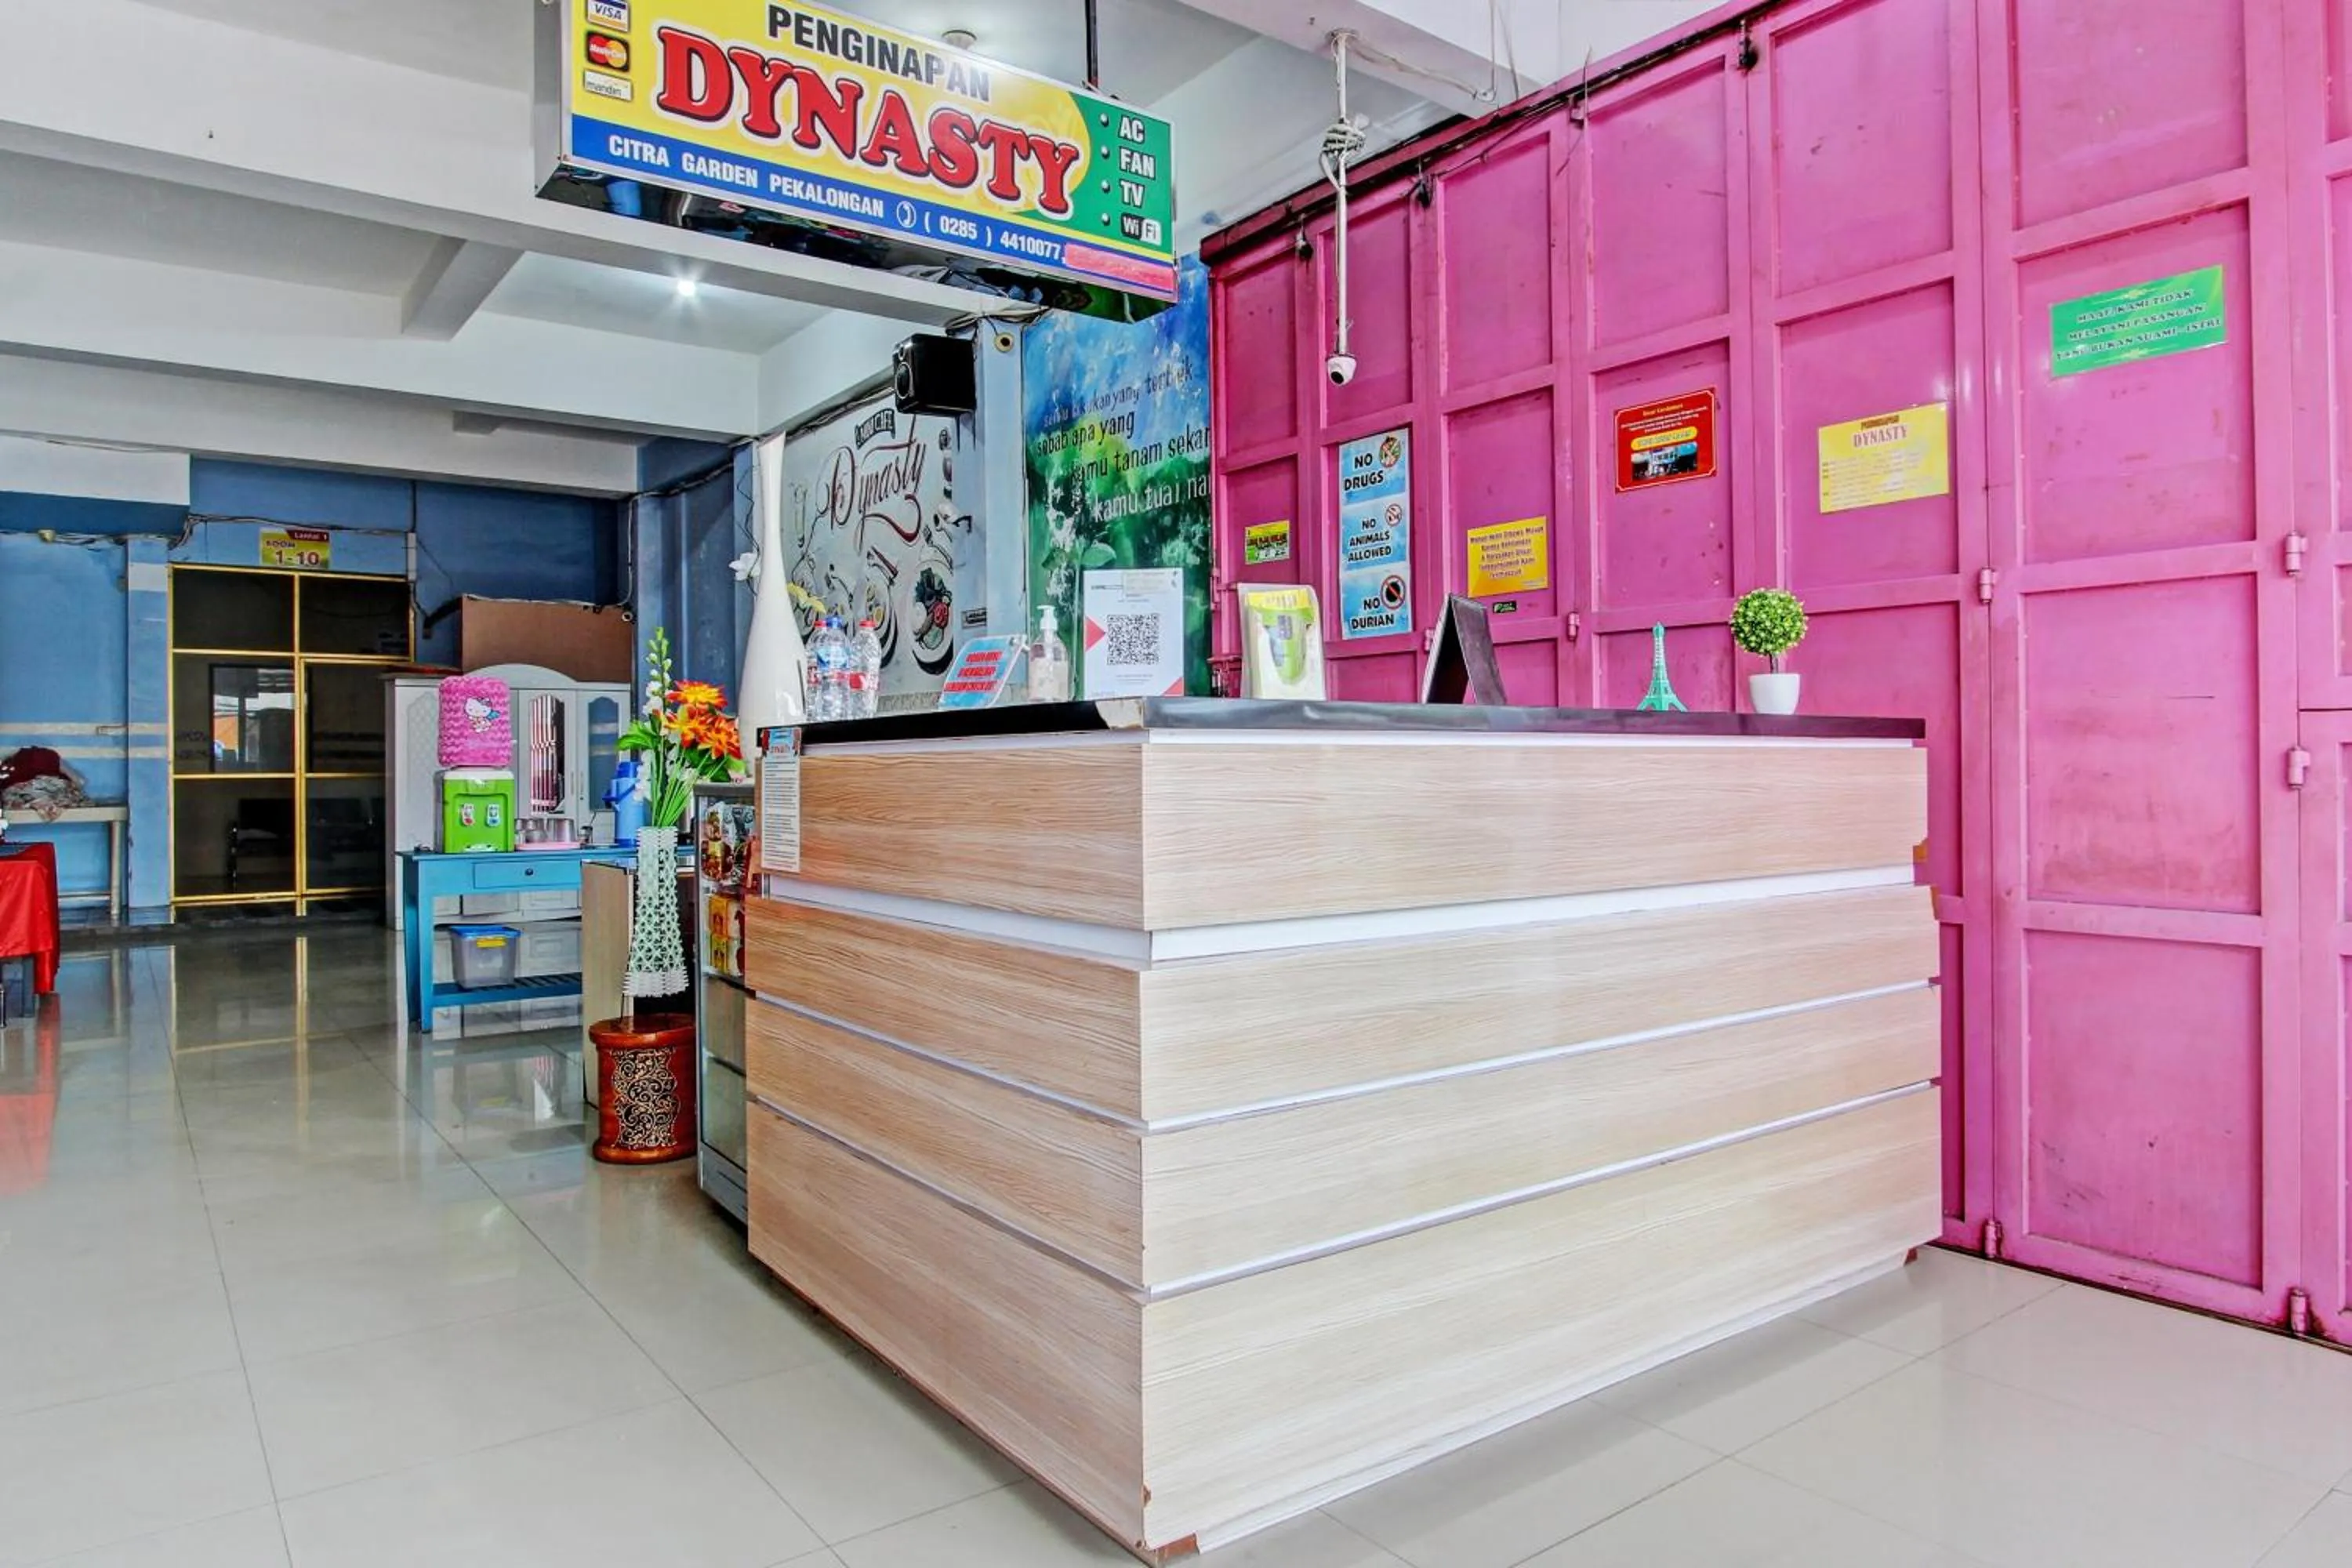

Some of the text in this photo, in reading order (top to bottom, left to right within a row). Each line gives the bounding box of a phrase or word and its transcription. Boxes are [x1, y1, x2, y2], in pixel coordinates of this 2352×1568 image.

[594, 3, 622, 20] VISA
[768, 3, 991, 103] PENGINAPAN
[657, 26, 1079, 214] DYNASTY
[1120, 115, 1145, 144] AC
[608, 134, 670, 168] CITRA
[681, 151, 759, 189] GARDEN
[769, 173, 884, 219] PEKALONGAN
[1120, 147, 1156, 180] FAN
[1120, 179, 1145, 208] TV
[1037, 425, 1069, 457] sebab
[1098, 410, 1135, 446] yang
[1853, 425, 1907, 448] DYNASTY
[1114, 442, 1163, 472] tanam
[1353, 452, 1373, 469] NO
[1343, 470, 1385, 492] DRUGS
[1094, 492, 1138, 523] kamu
[1361, 517, 1377, 530] NO
[1349, 530, 1391, 548] ANIMALS
[1347, 545, 1392, 563] ALLOWED
[1363, 596, 1381, 611] NO
[1350, 613, 1395, 631] DURIAN
